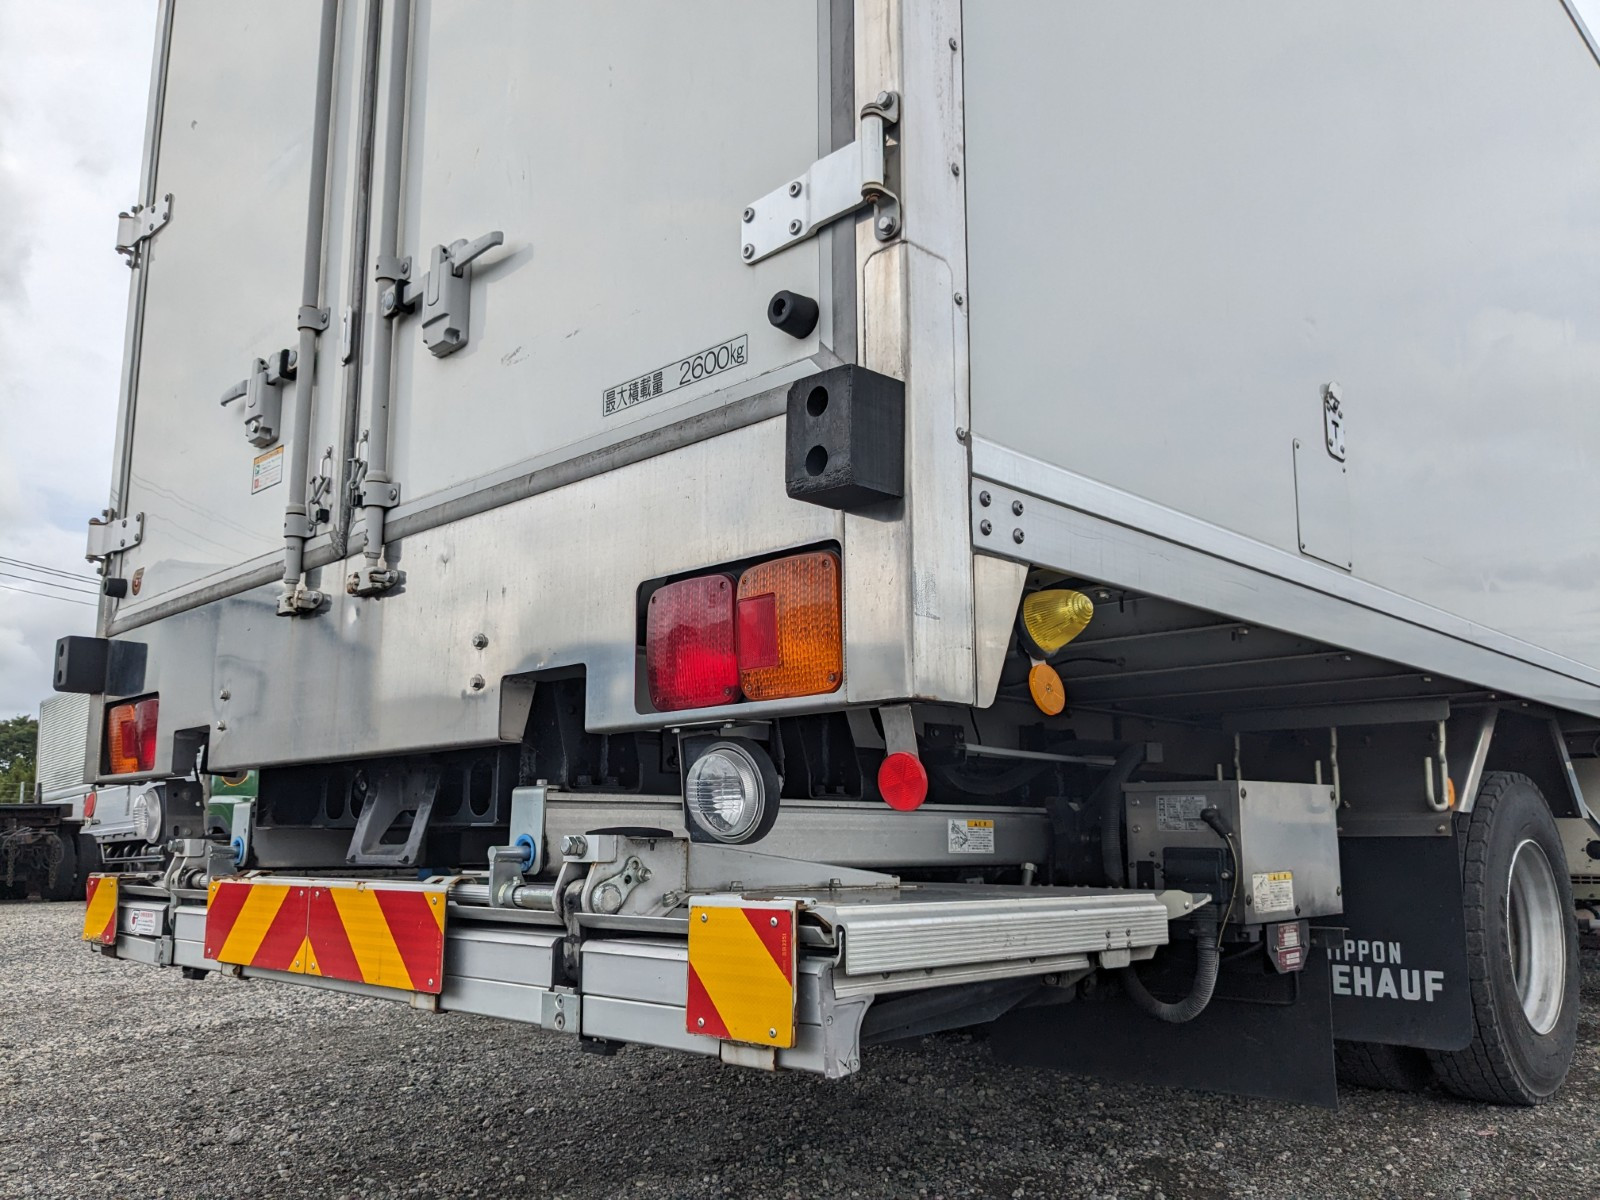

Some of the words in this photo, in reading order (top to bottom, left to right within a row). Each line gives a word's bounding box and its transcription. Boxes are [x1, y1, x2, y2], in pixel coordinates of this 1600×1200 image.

[605, 371, 664, 413] 最大積載量
[679, 343, 745, 386] 2600kg
[1327, 939, 1402, 965] IPPON
[1331, 964, 1444, 1002] EHAUF
